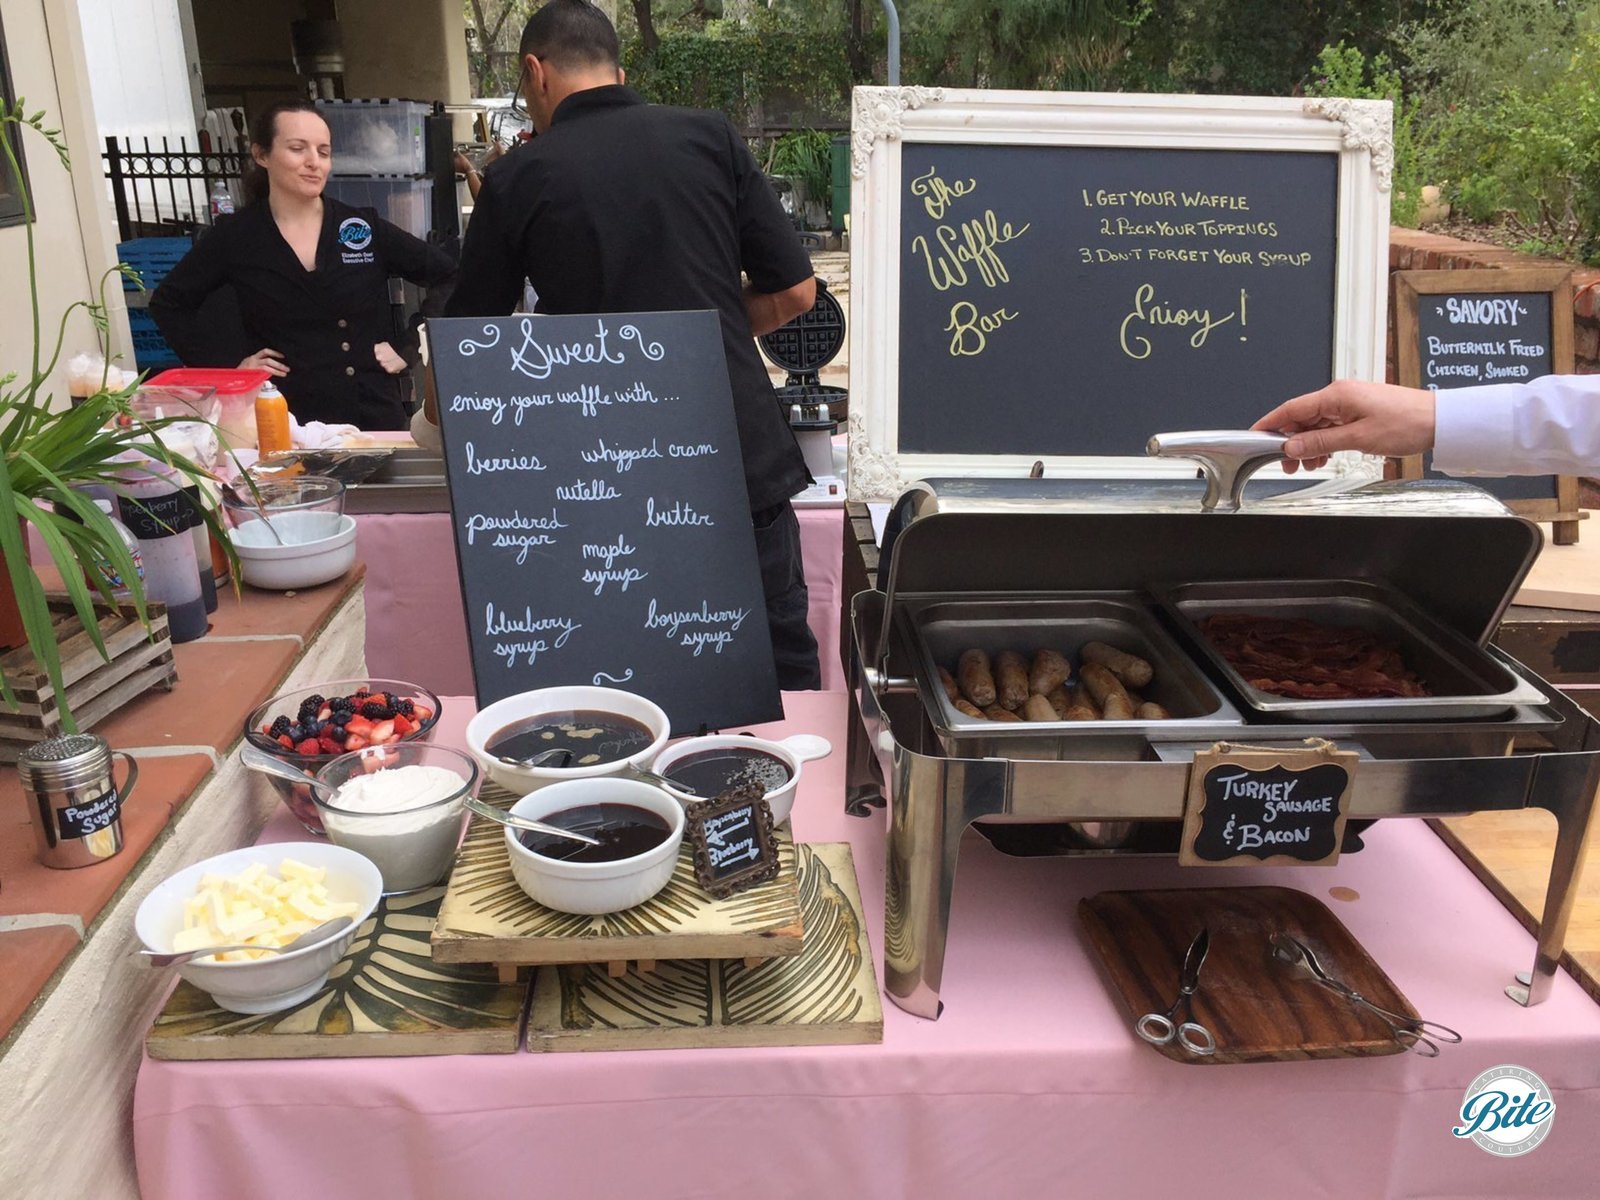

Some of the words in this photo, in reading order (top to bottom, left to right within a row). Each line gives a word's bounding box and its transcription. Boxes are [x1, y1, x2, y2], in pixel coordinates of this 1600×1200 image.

[1096, 189, 1128, 206] GET
[1130, 190, 1178, 207] YOUR
[1181, 190, 1250, 211] WAFFLE
[337, 224, 372, 244] Bite
[1116, 216, 1156, 236] PICK
[1155, 220, 1197, 237] YOUR
[1197, 219, 1279, 238] TOPPINGS
[912, 209, 1031, 292] Waffle
[1095, 247, 1143, 263] DON'T
[1148, 248, 1210, 263] FORGET
[1213, 248, 1254, 266] YOUR
[1446, 297, 1518, 326] SAVORY
[944, 301, 1019, 356] Bar
[510, 318, 625, 379] Sweet
[1427, 336, 1506, 356] BUTTERMILK
[1508, 339, 1545, 357] FRIED
[1485, 361, 1530, 379] SMOKED
[510, 395, 554, 426] your
[556, 384, 614, 417] waffle
[465, 441, 547, 473] berries
[580, 438, 664, 474] whipped
[556, 478, 622, 501] nutella
[464, 507, 569, 546] powdered
[646, 497, 714, 527] butter
[492, 533, 557, 565] sugar
[582, 534, 637, 569] maple
[581, 568, 649, 596] syrup
[485, 602, 583, 650] blueberry
[644, 598, 753, 639] boysenberry
[493, 636, 550, 668] syrup
[680, 628, 735, 657] syrup
[1216, 772, 1299, 801] TURKEY
[65, 789, 117, 822] Powdered
[81, 804, 117, 833] Sugar
[1262, 796, 1334, 823] SAUSAGE
[1236, 824, 1311, 851] BACON
